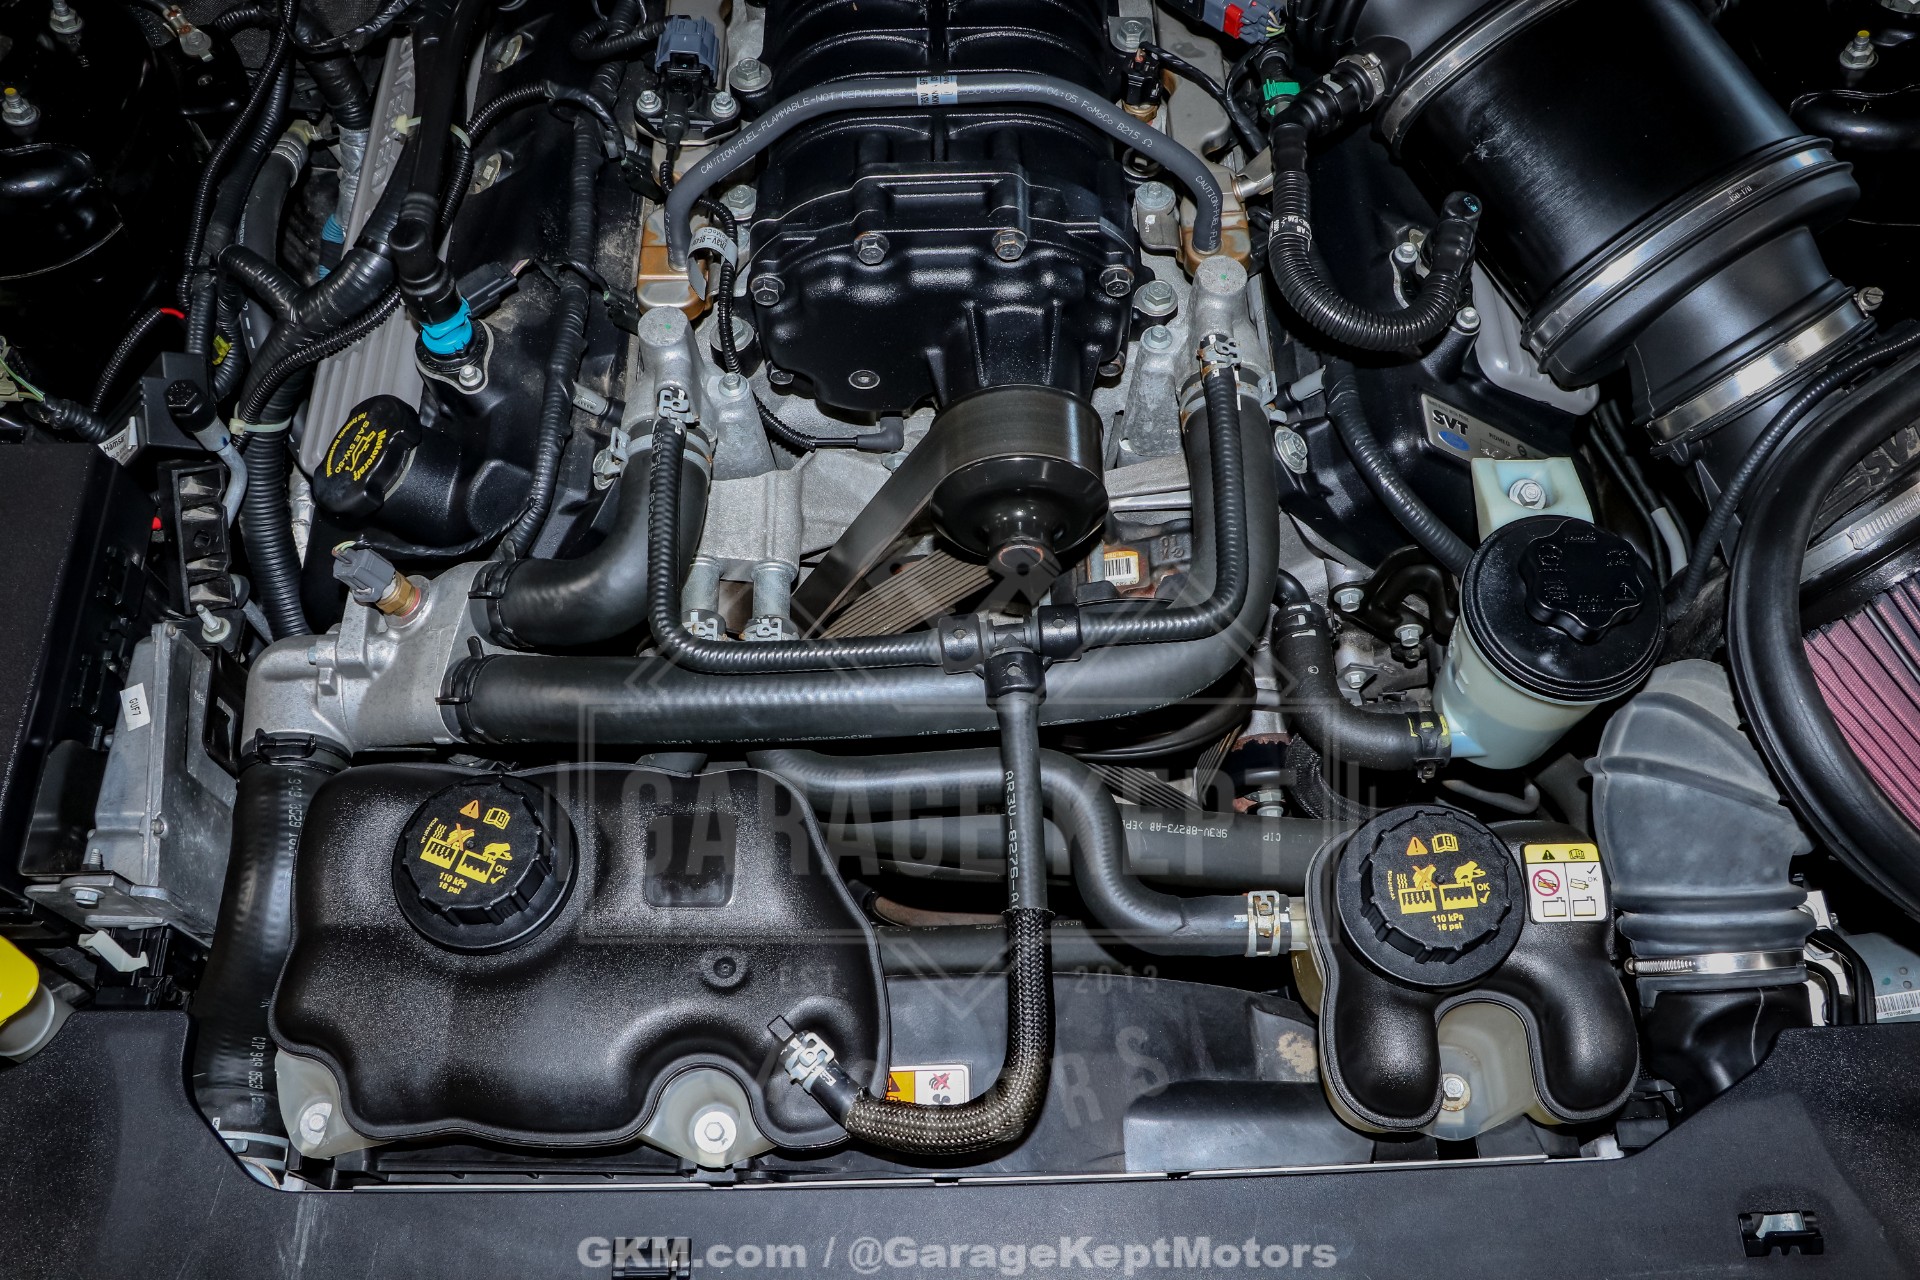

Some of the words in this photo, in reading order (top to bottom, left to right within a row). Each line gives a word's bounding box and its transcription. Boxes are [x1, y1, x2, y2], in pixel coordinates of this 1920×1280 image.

[1046, 85, 1078, 104] 04:05
[1080, 98, 1114, 126] FoMoCo
[1116, 121, 1141, 141] B215
[1432, 409, 1468, 436] SVT
[353, 420, 370, 443] SAE
[334, 443, 356, 474] 5W-50
[353, 428, 387, 482] Motorcraft
[1262, 831, 1282, 842] CIP
[495, 864, 509, 875] OK
[438, 881, 449, 891] 16
[447, 884, 462, 895] psi
[439, 871, 454, 883] 110
[453, 875, 468, 889] kPa
[1476, 882, 1491, 891] OK
[1431, 914, 1447, 924] 110
[1448, 912, 1465, 923] kPa
[1437, 923, 1448, 932] 16
[1448, 922, 1463, 932] psi
